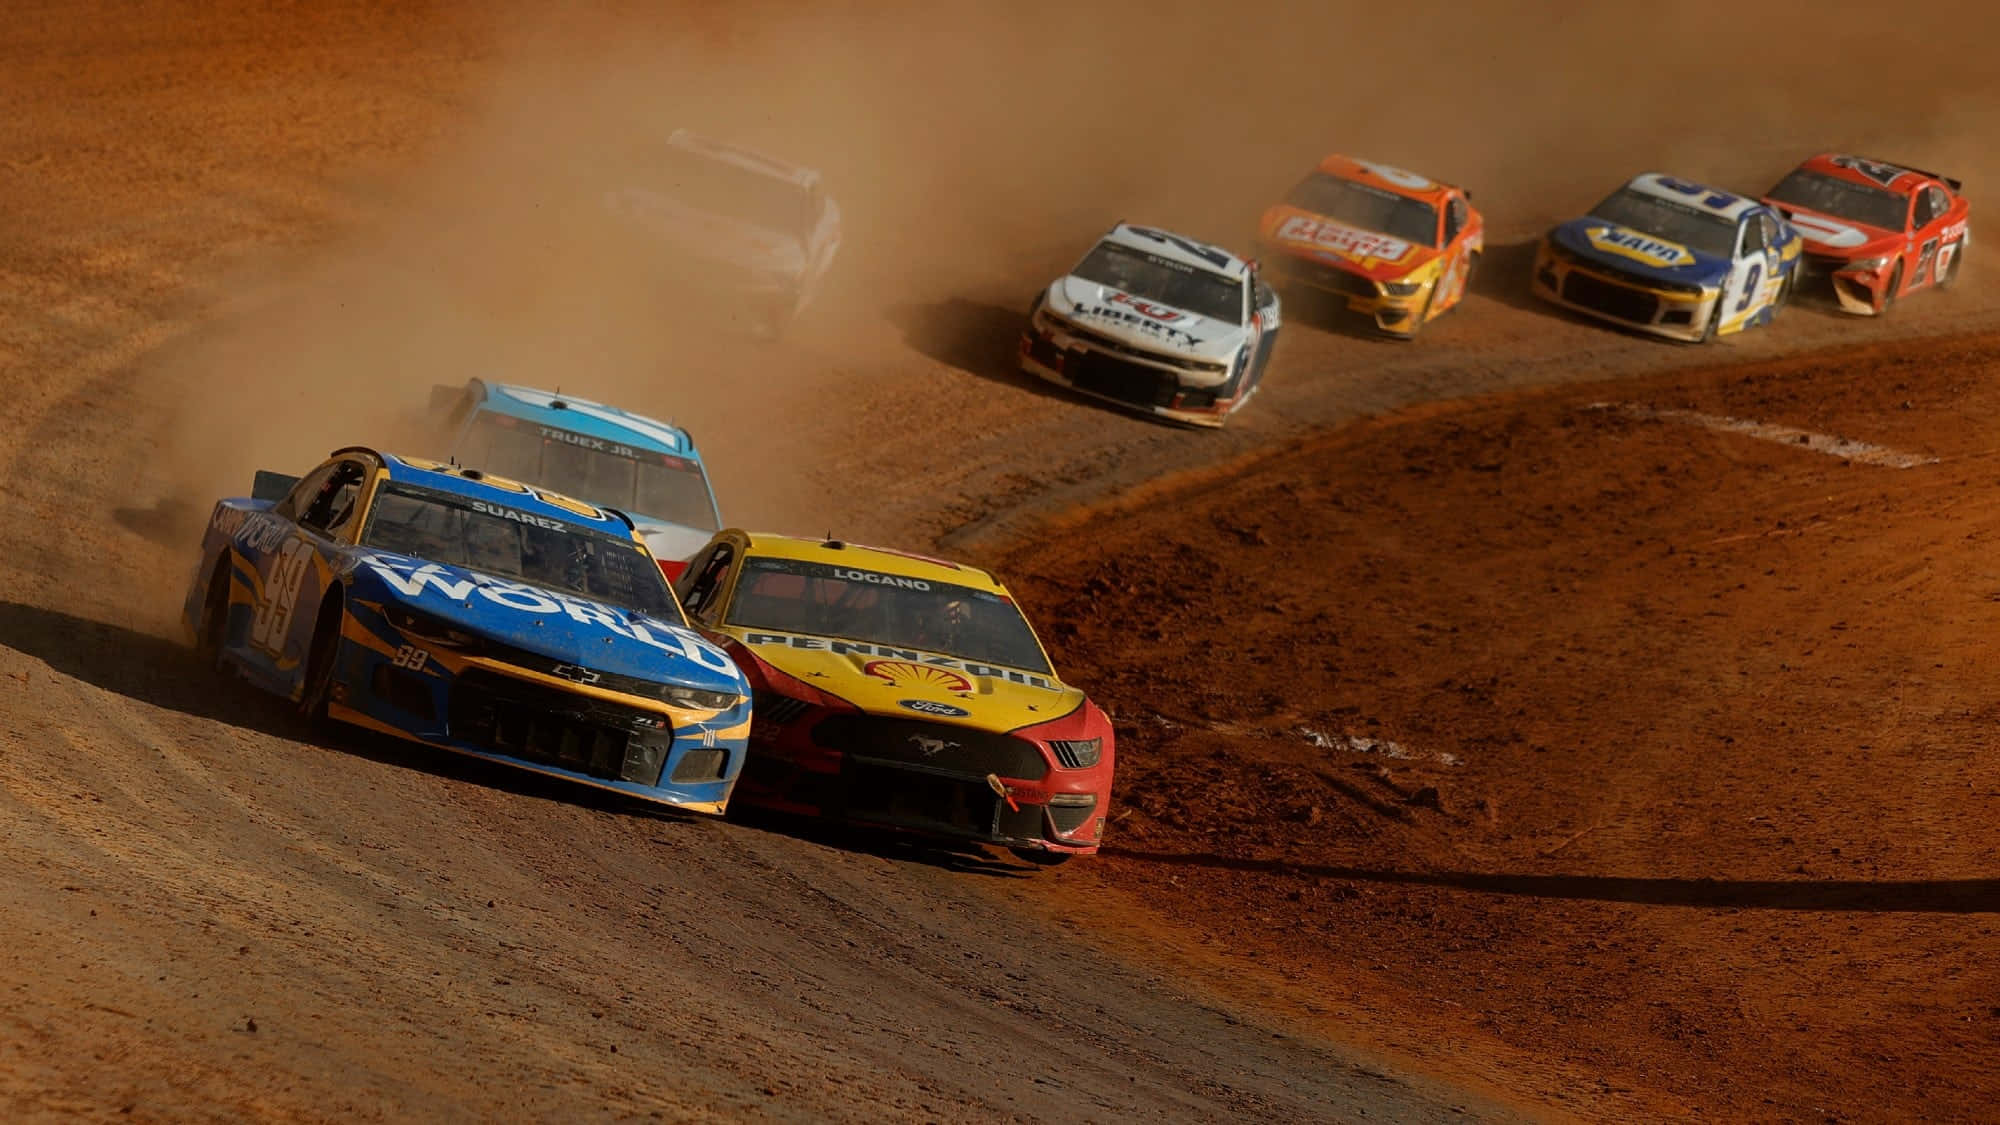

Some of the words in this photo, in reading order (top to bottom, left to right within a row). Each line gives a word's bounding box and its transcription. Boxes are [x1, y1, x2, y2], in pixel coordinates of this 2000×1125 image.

[1602, 231, 1679, 260] NAPA
[1736, 263, 1761, 312] 9
[1073, 303, 1205, 347] LIBERTY
[539, 427, 605, 451] TRUEX
[609, 444, 640, 458] JR.
[471, 501, 567, 533] SUAREZ
[834, 568, 930, 593] LOGANO
[371, 565, 741, 680] WORLD
[391, 644, 430, 672] 99
[744, 633, 1063, 692] PENNZOIL
[911, 699, 958, 716] Ford
